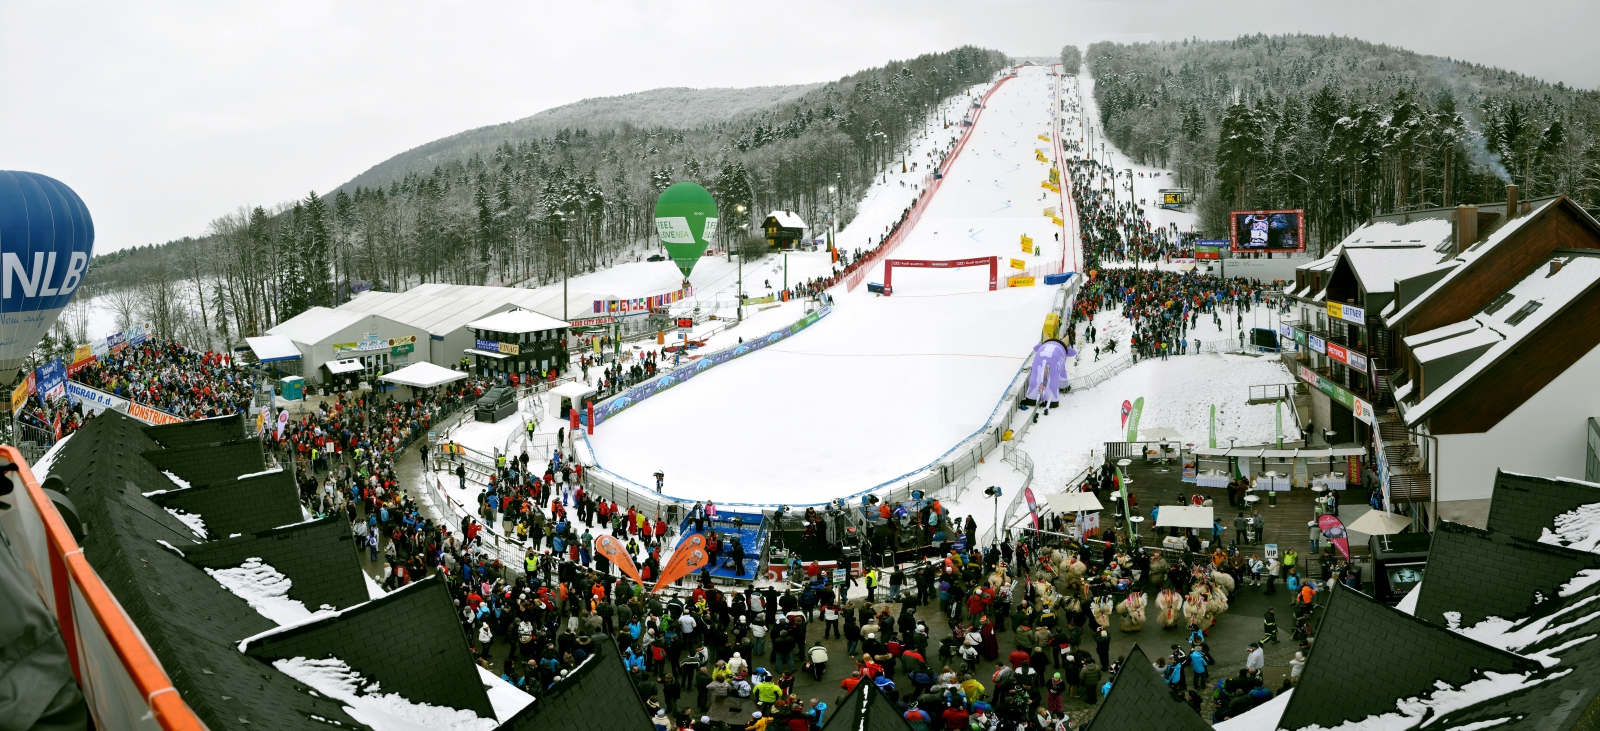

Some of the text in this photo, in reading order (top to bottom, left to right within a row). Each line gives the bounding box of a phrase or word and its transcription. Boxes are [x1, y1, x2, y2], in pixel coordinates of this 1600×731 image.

[2, 251, 87, 298] NLB
[1342, 306, 1362, 319] LEITNER
[500, 343, 518, 353] VINAG
[1327, 345, 1346, 359] PETROL
[1266, 549, 1277, 557] VIP
